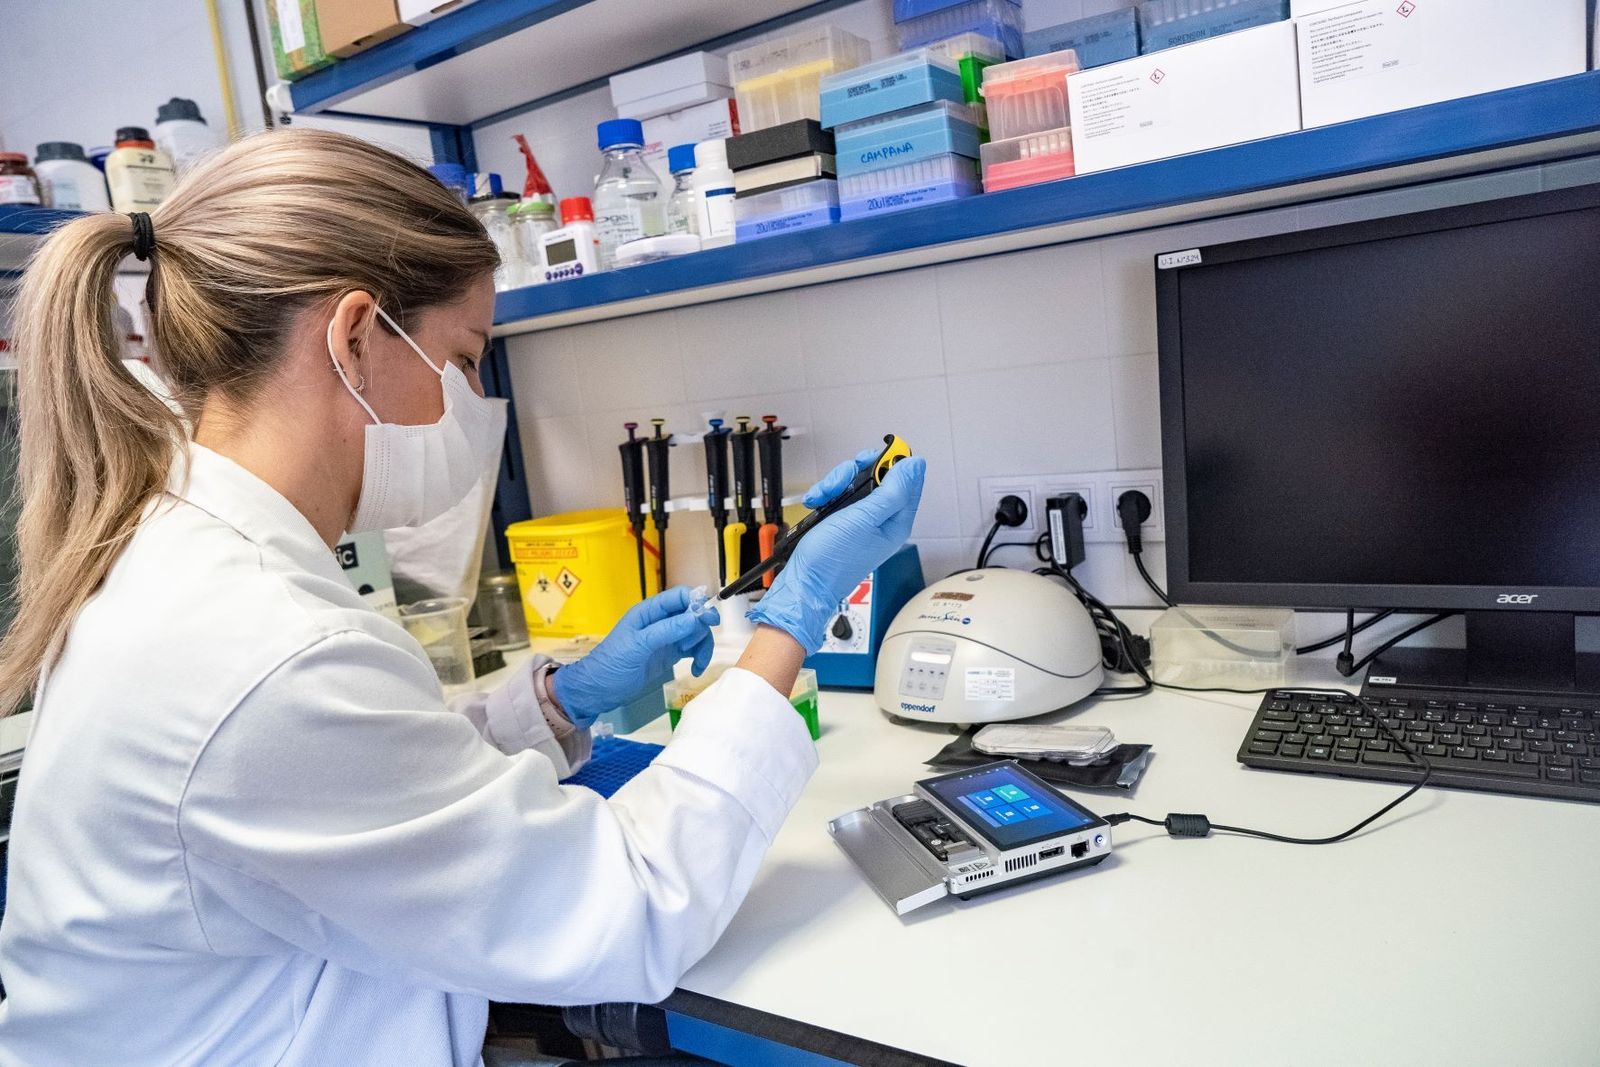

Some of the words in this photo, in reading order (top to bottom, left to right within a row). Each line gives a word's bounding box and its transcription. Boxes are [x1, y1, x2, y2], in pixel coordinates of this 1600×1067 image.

[861, 142, 914, 164] CAMPANA
[1496, 594, 1538, 604] acer
[900, 702, 936, 713] eppendorf
